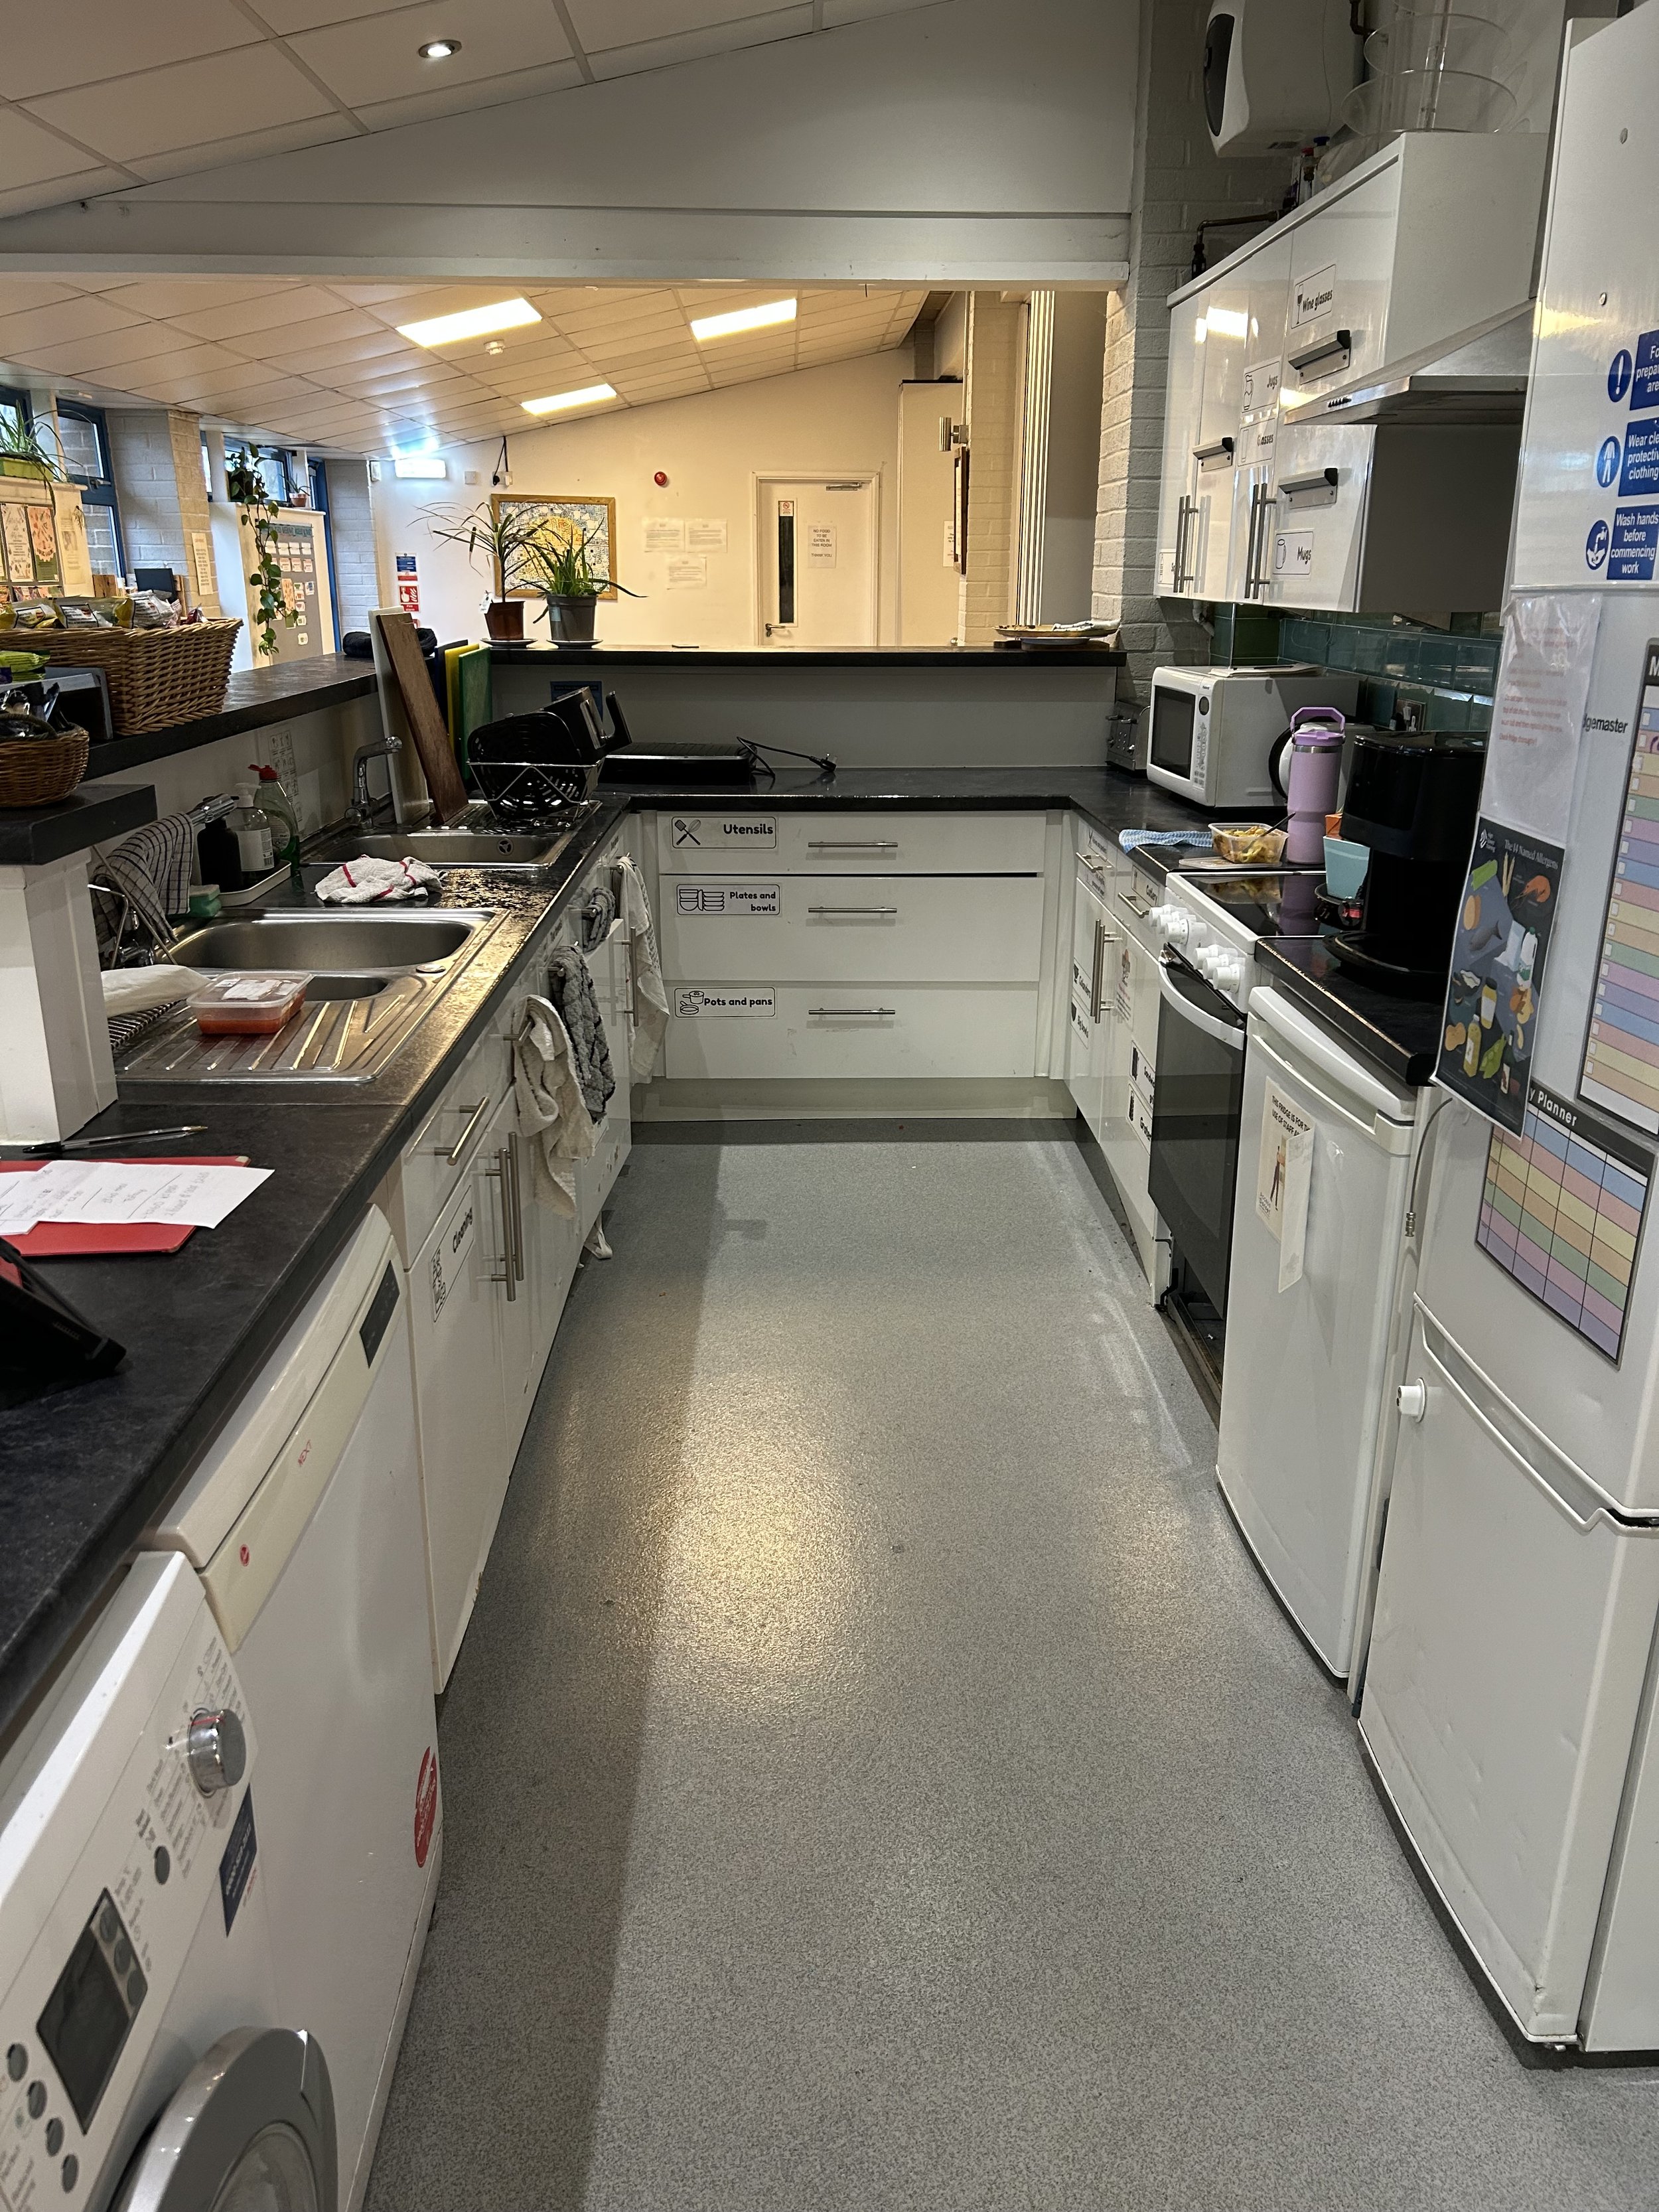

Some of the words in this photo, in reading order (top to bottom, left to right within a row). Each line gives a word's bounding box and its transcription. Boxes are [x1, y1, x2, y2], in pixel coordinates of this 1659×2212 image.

[1302, 297, 1313, 313] Wine
[1314, 288, 1333, 311] glasses
[1267, 374, 1278, 390] Jugs
[1257, 433, 1273, 447] Gasses
[1628, 435, 1647, 448] Wear
[1628, 465, 1659, 480] clothing
[1617, 513, 1636, 526] Wash
[1636, 511, 1659, 525] hands
[1624, 529, 1646, 542] before
[1297, 546, 1311, 564] Mugs
[1611, 545, 1655, 560] commencing
[1622, 561, 1639, 574] work
[723, 823, 774, 835] Utensils
[1518, 845, 1536, 861] Named
[730, 891, 758, 900] Plates
[760, 891, 776, 899] and
[1146, 884, 1158, 906] Cutlery
[704, 997, 726, 1007] Pots
[729, 997, 747, 1006] and
[749, 997, 772, 1008] pans
[1538, 1090, 1577, 1126] Planner
[1278, 1102, 1291, 1120] FRIDGE
[1295, 1117, 1304, 1130] FOR
[453, 1207, 473, 1254] Cleaning
